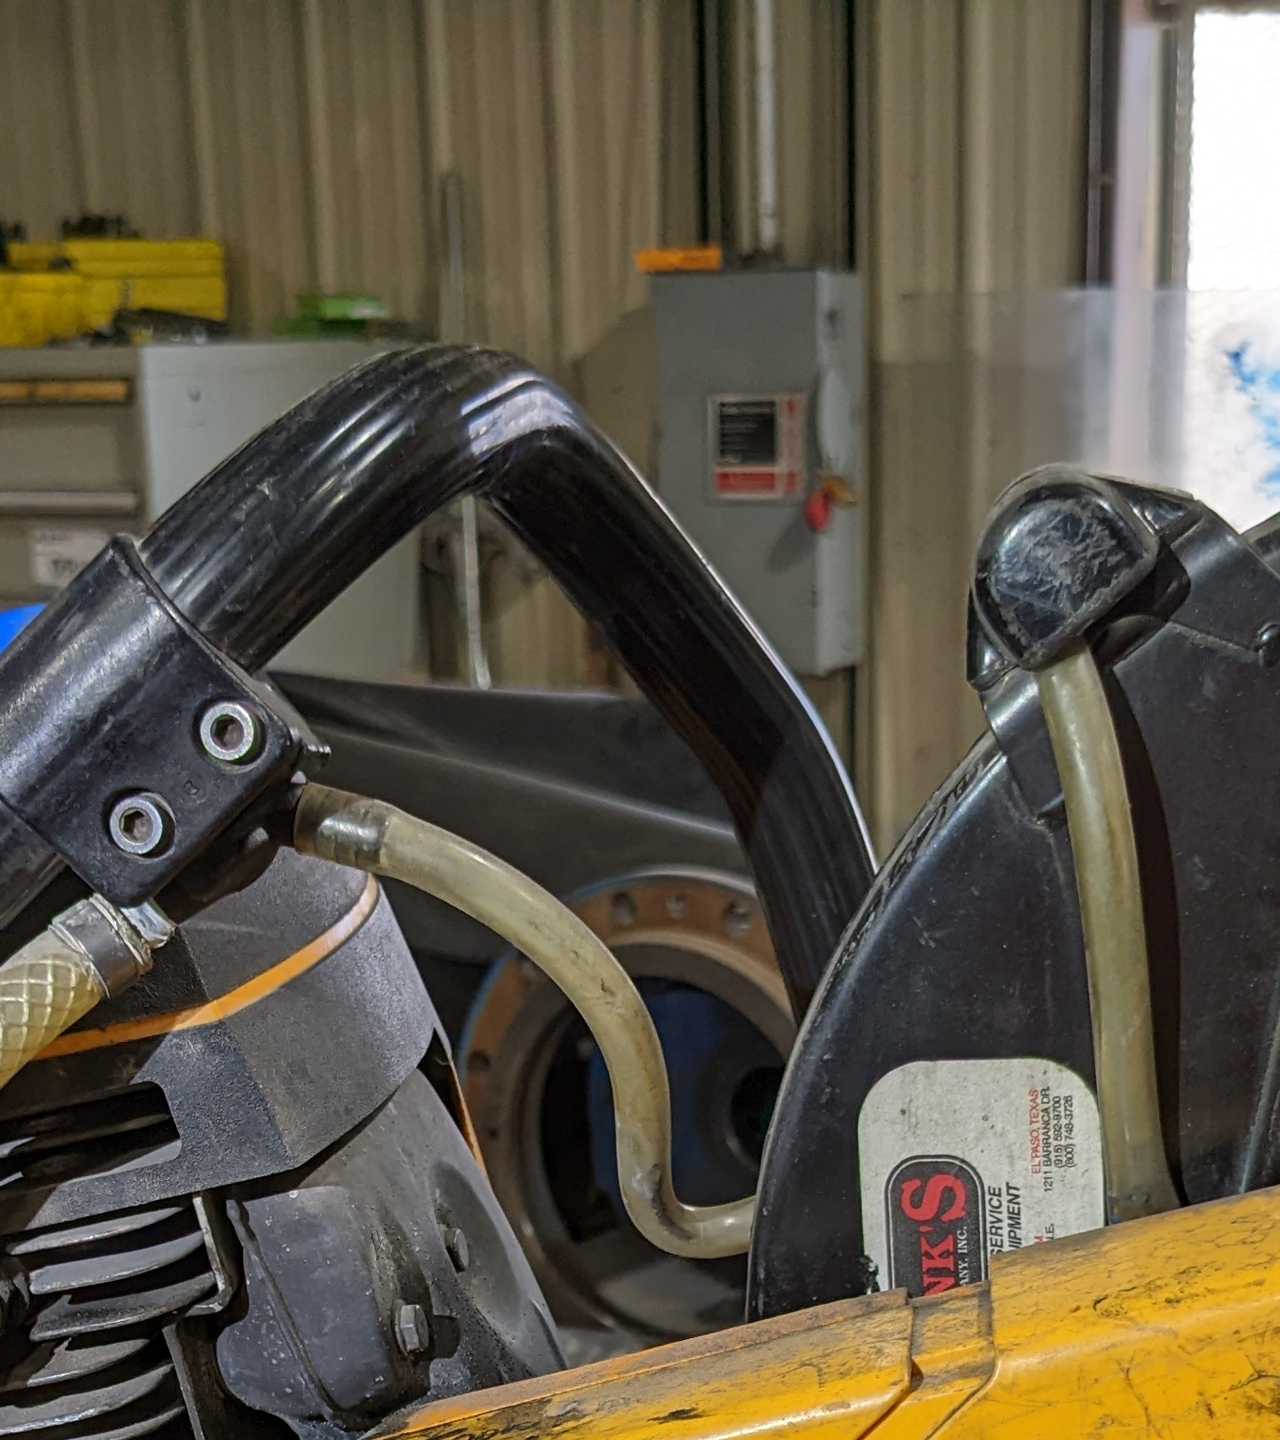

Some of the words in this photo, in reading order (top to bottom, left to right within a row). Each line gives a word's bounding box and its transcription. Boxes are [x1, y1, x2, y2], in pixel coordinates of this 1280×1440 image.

[1028, 1088, 1040, 1125] TEXAS
[1041, 1106, 1052, 1167] BARRANCA
[1043, 1171, 1054, 1192] 1211
[957, 1226, 968, 1254] INC.
